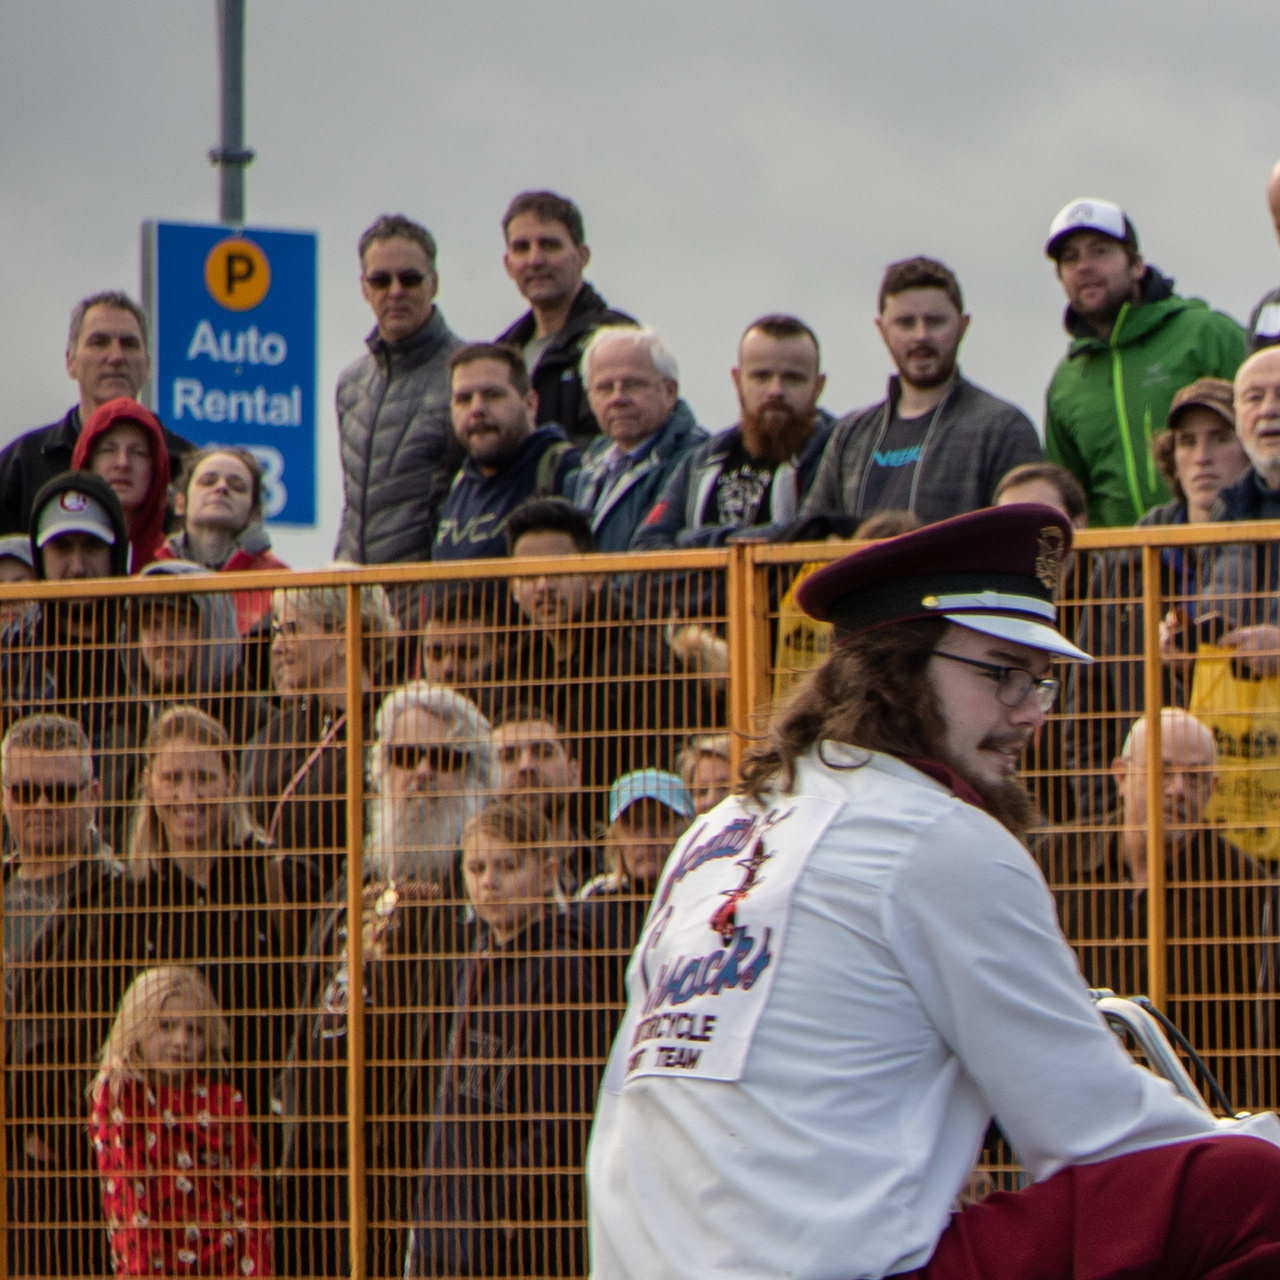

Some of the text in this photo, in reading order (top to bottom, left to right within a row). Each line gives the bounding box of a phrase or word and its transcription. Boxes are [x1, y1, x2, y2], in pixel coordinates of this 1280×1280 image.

[226, 254, 255, 294] P
[187, 319, 288, 366] Auto
[173, 378, 302, 427] Rental
[654, 1046, 703, 1069] TEAM
